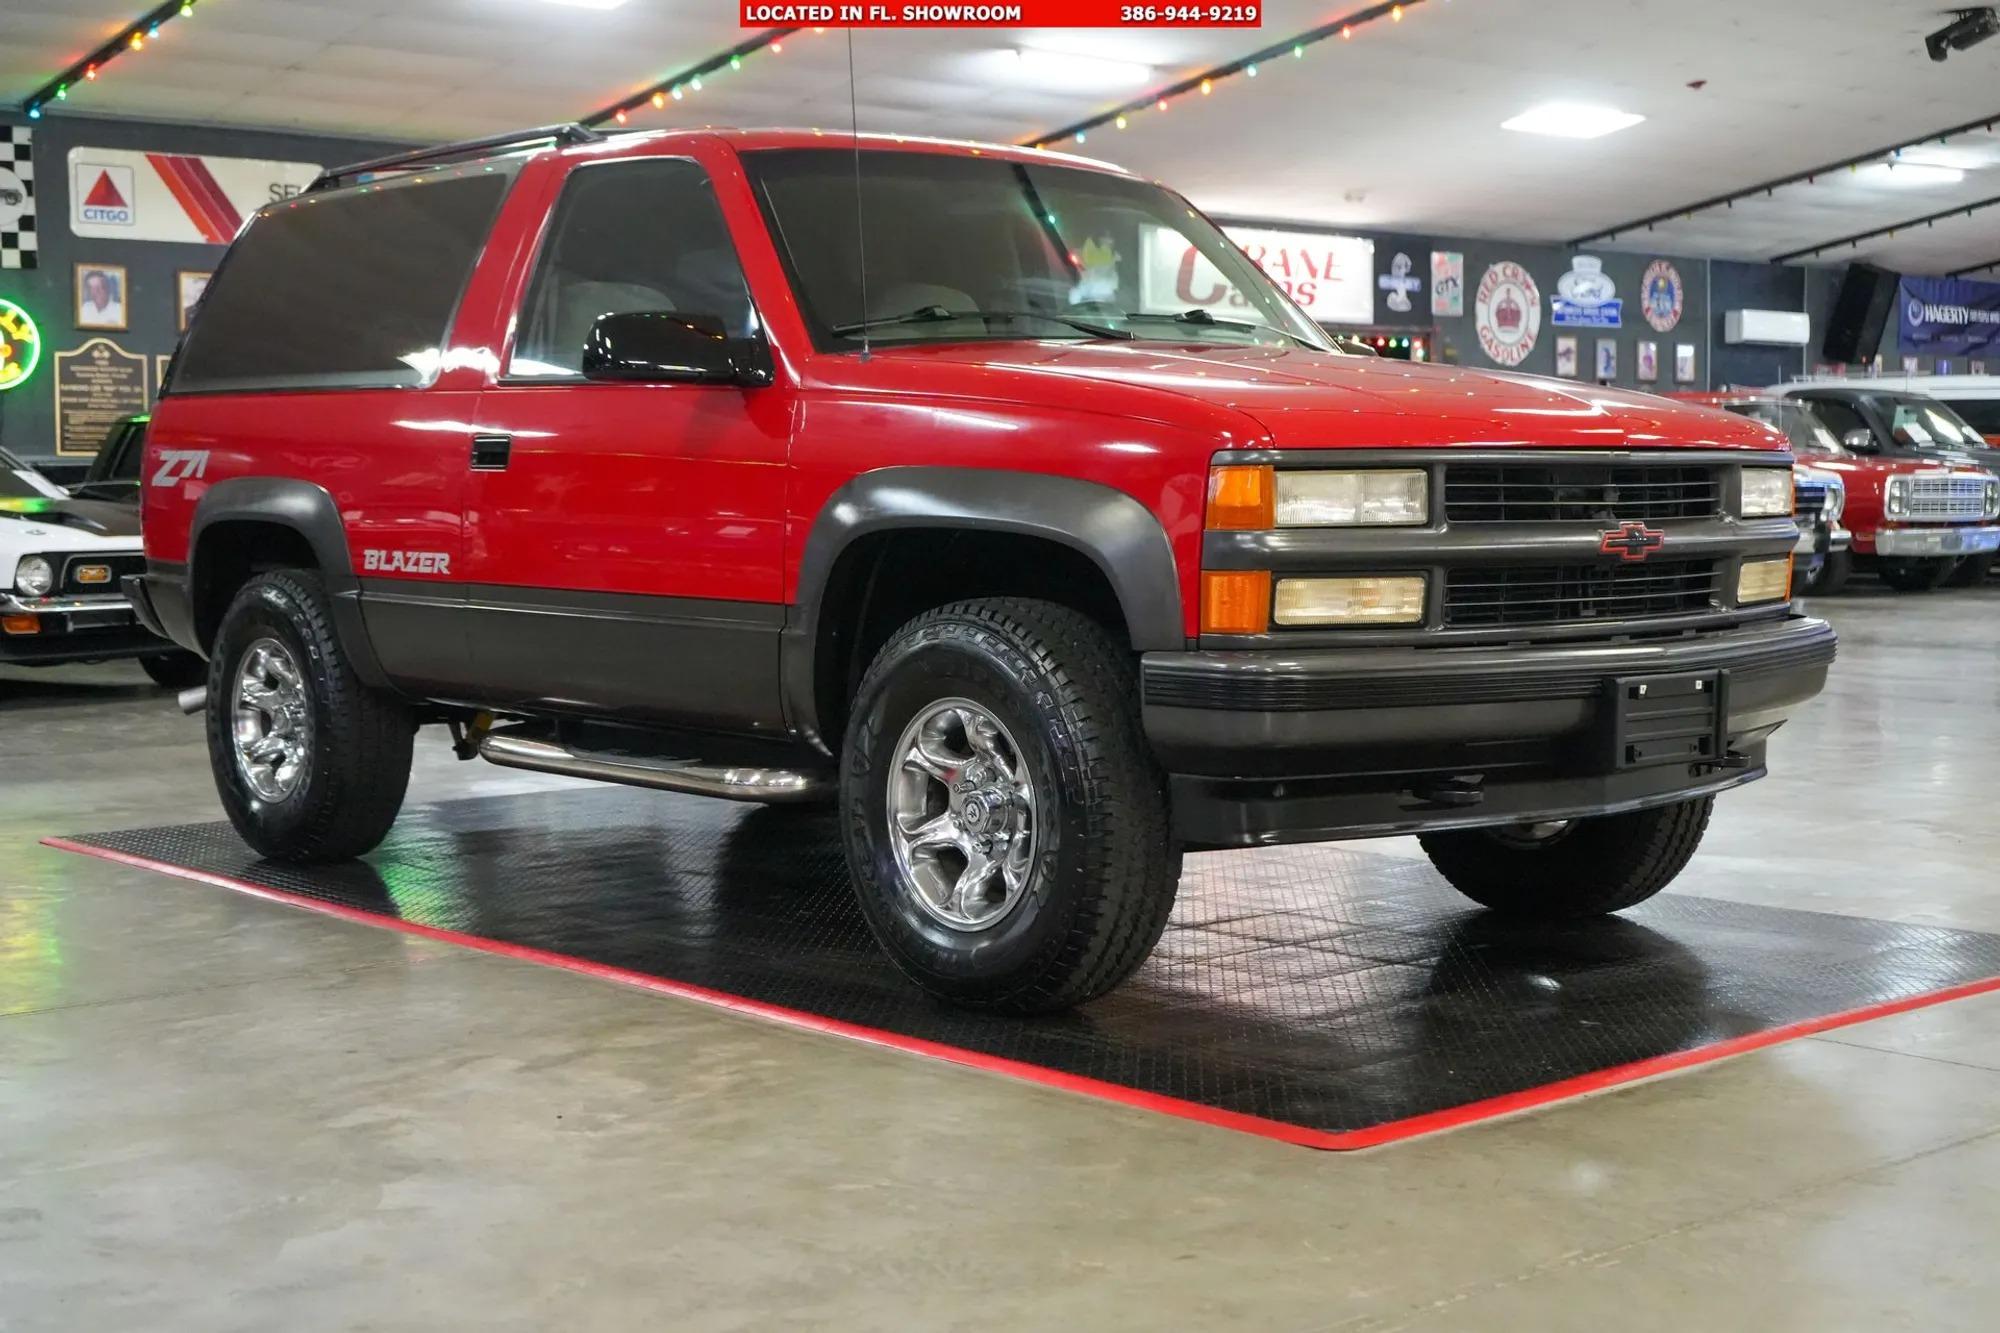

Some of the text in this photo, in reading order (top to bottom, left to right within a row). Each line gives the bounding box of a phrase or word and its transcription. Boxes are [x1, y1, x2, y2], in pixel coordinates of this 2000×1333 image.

[83, 208, 129, 222] CITGO
[1924, 304, 1969, 325] HAGERTY
[152, 450, 210, 487] Z71
[364, 549, 450, 575] BLAZER
